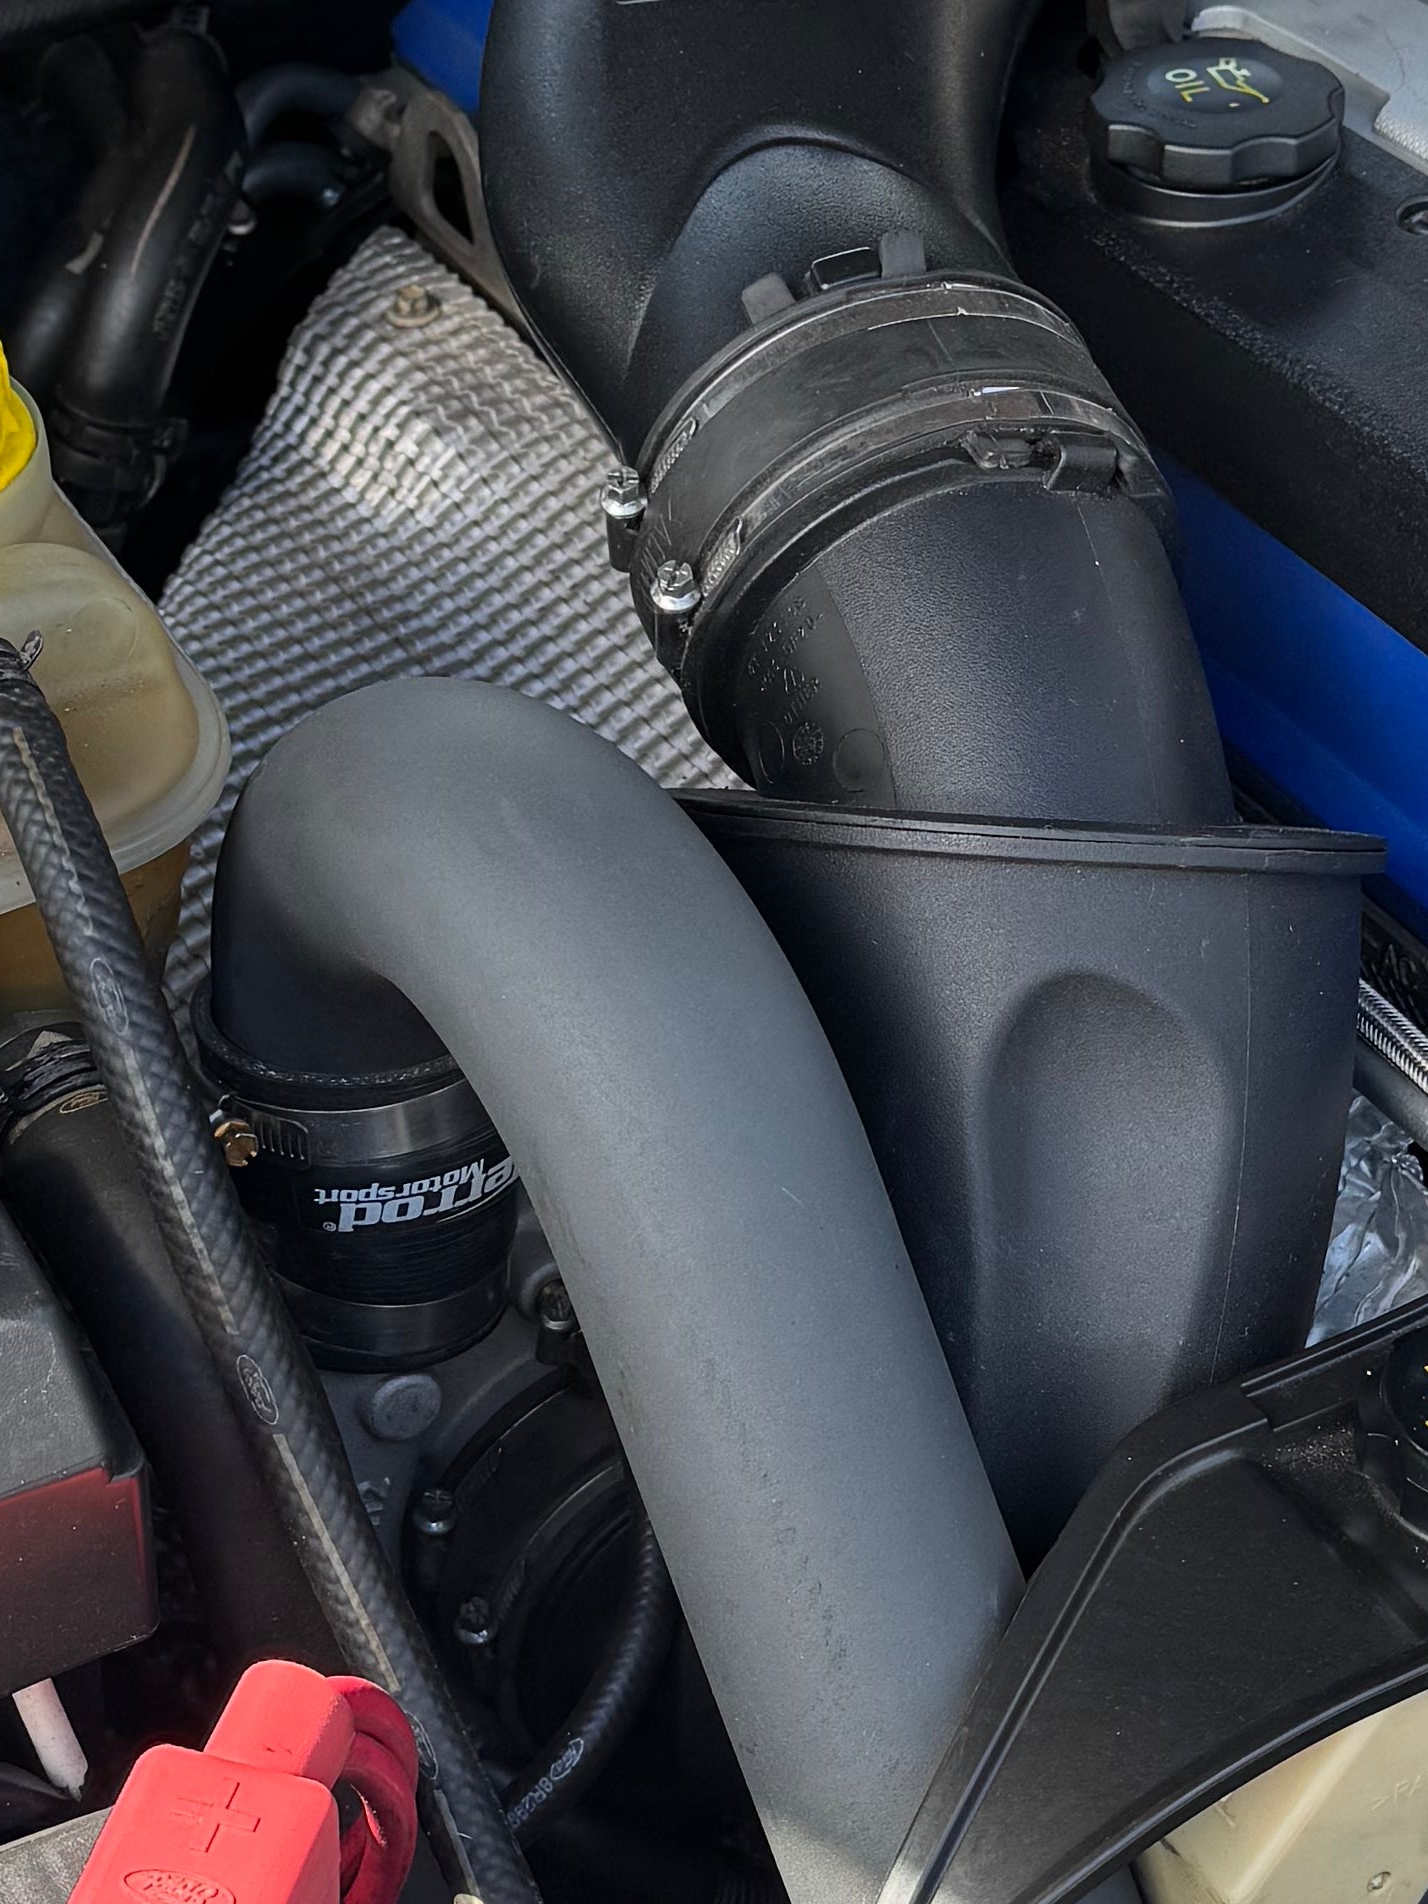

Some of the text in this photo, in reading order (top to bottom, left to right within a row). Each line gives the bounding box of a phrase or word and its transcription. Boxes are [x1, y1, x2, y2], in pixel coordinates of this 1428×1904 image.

[1165, 69, 1211, 102] OIL
[314, 1158, 485, 1204] Motorsport
[338, 1156, 516, 1232] errod
